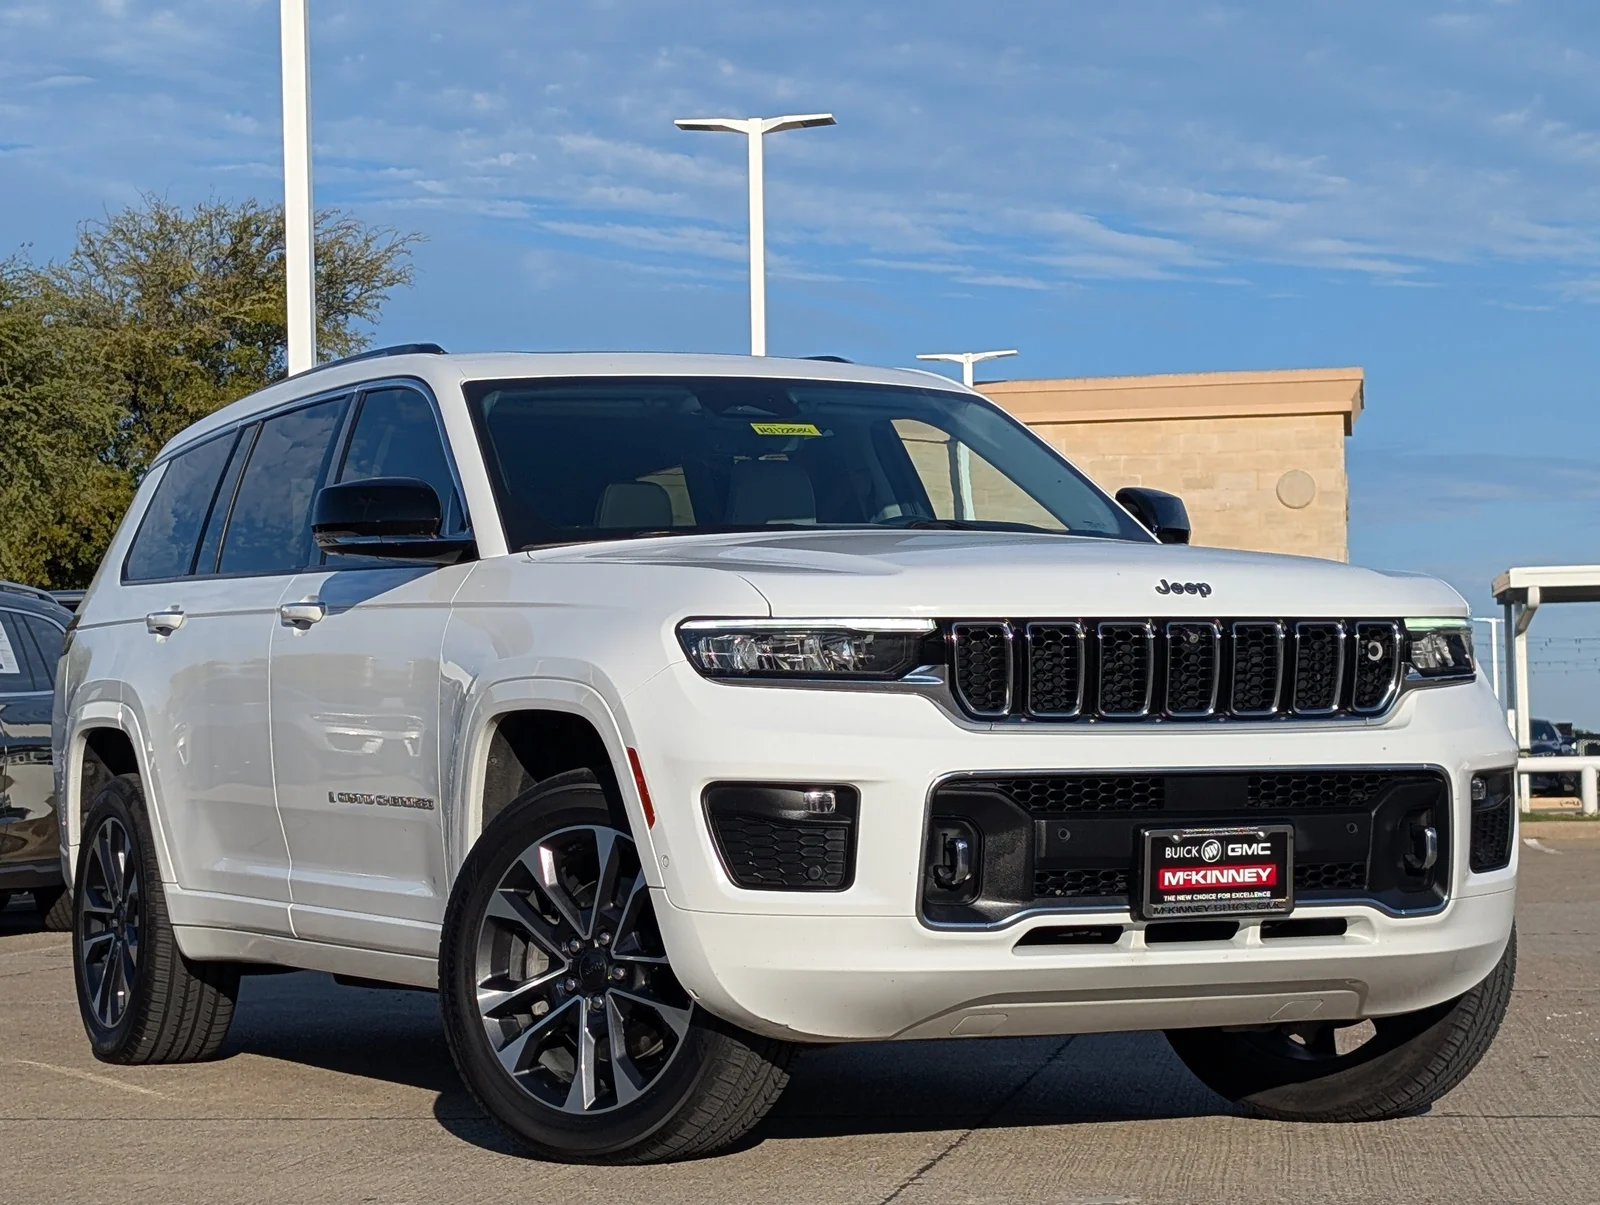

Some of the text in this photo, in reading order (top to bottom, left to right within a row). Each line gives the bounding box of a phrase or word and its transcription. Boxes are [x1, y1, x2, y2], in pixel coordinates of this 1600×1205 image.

[1155, 579, 1212, 598] Jeep
[1165, 843, 1272, 859] BUICK GMC
[1164, 868, 1272, 886] McKINNEY
